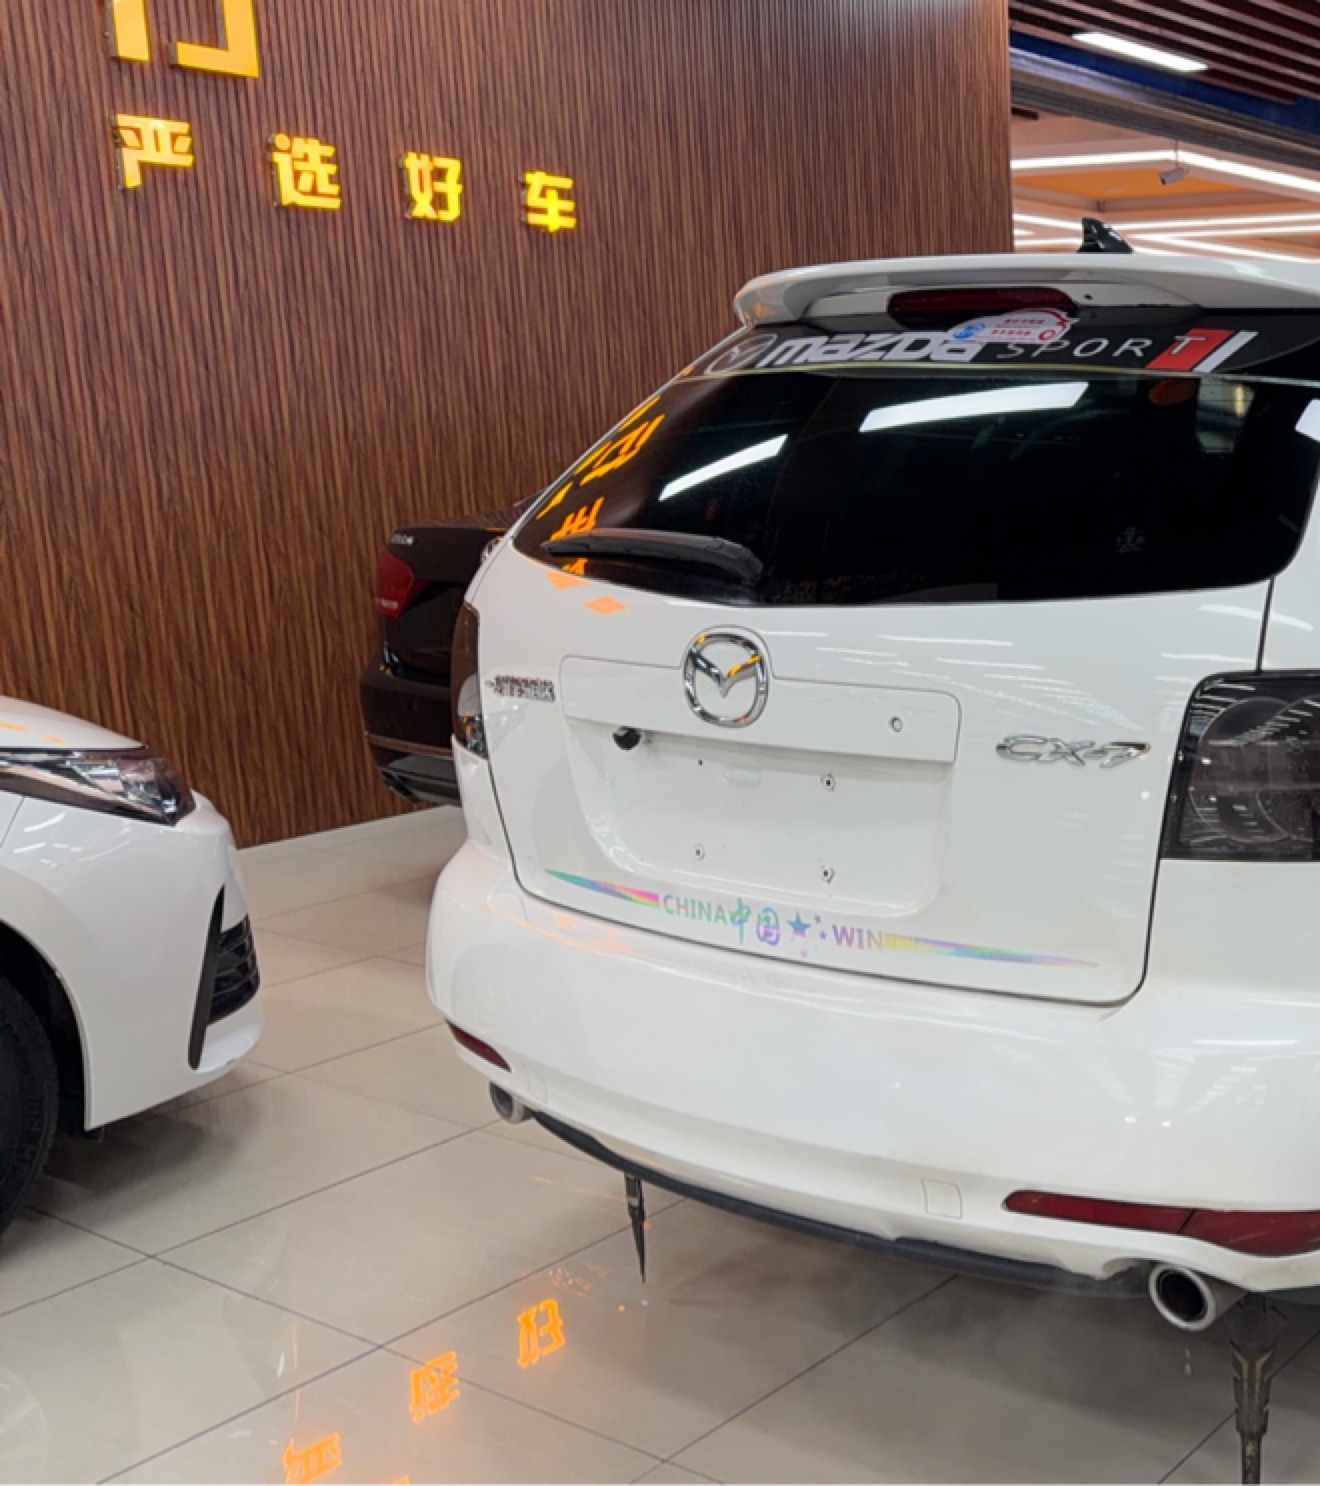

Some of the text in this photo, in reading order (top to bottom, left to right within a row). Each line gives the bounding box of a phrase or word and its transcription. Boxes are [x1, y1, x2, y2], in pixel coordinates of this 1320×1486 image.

[114, 113, 578, 233] 严选好车
[996, 335, 1207, 360] SPORT
[996, 734, 1152, 768] CX-7
[663, 894, 728, 926] CHINA
[832, 923, 885, 949] WIN
